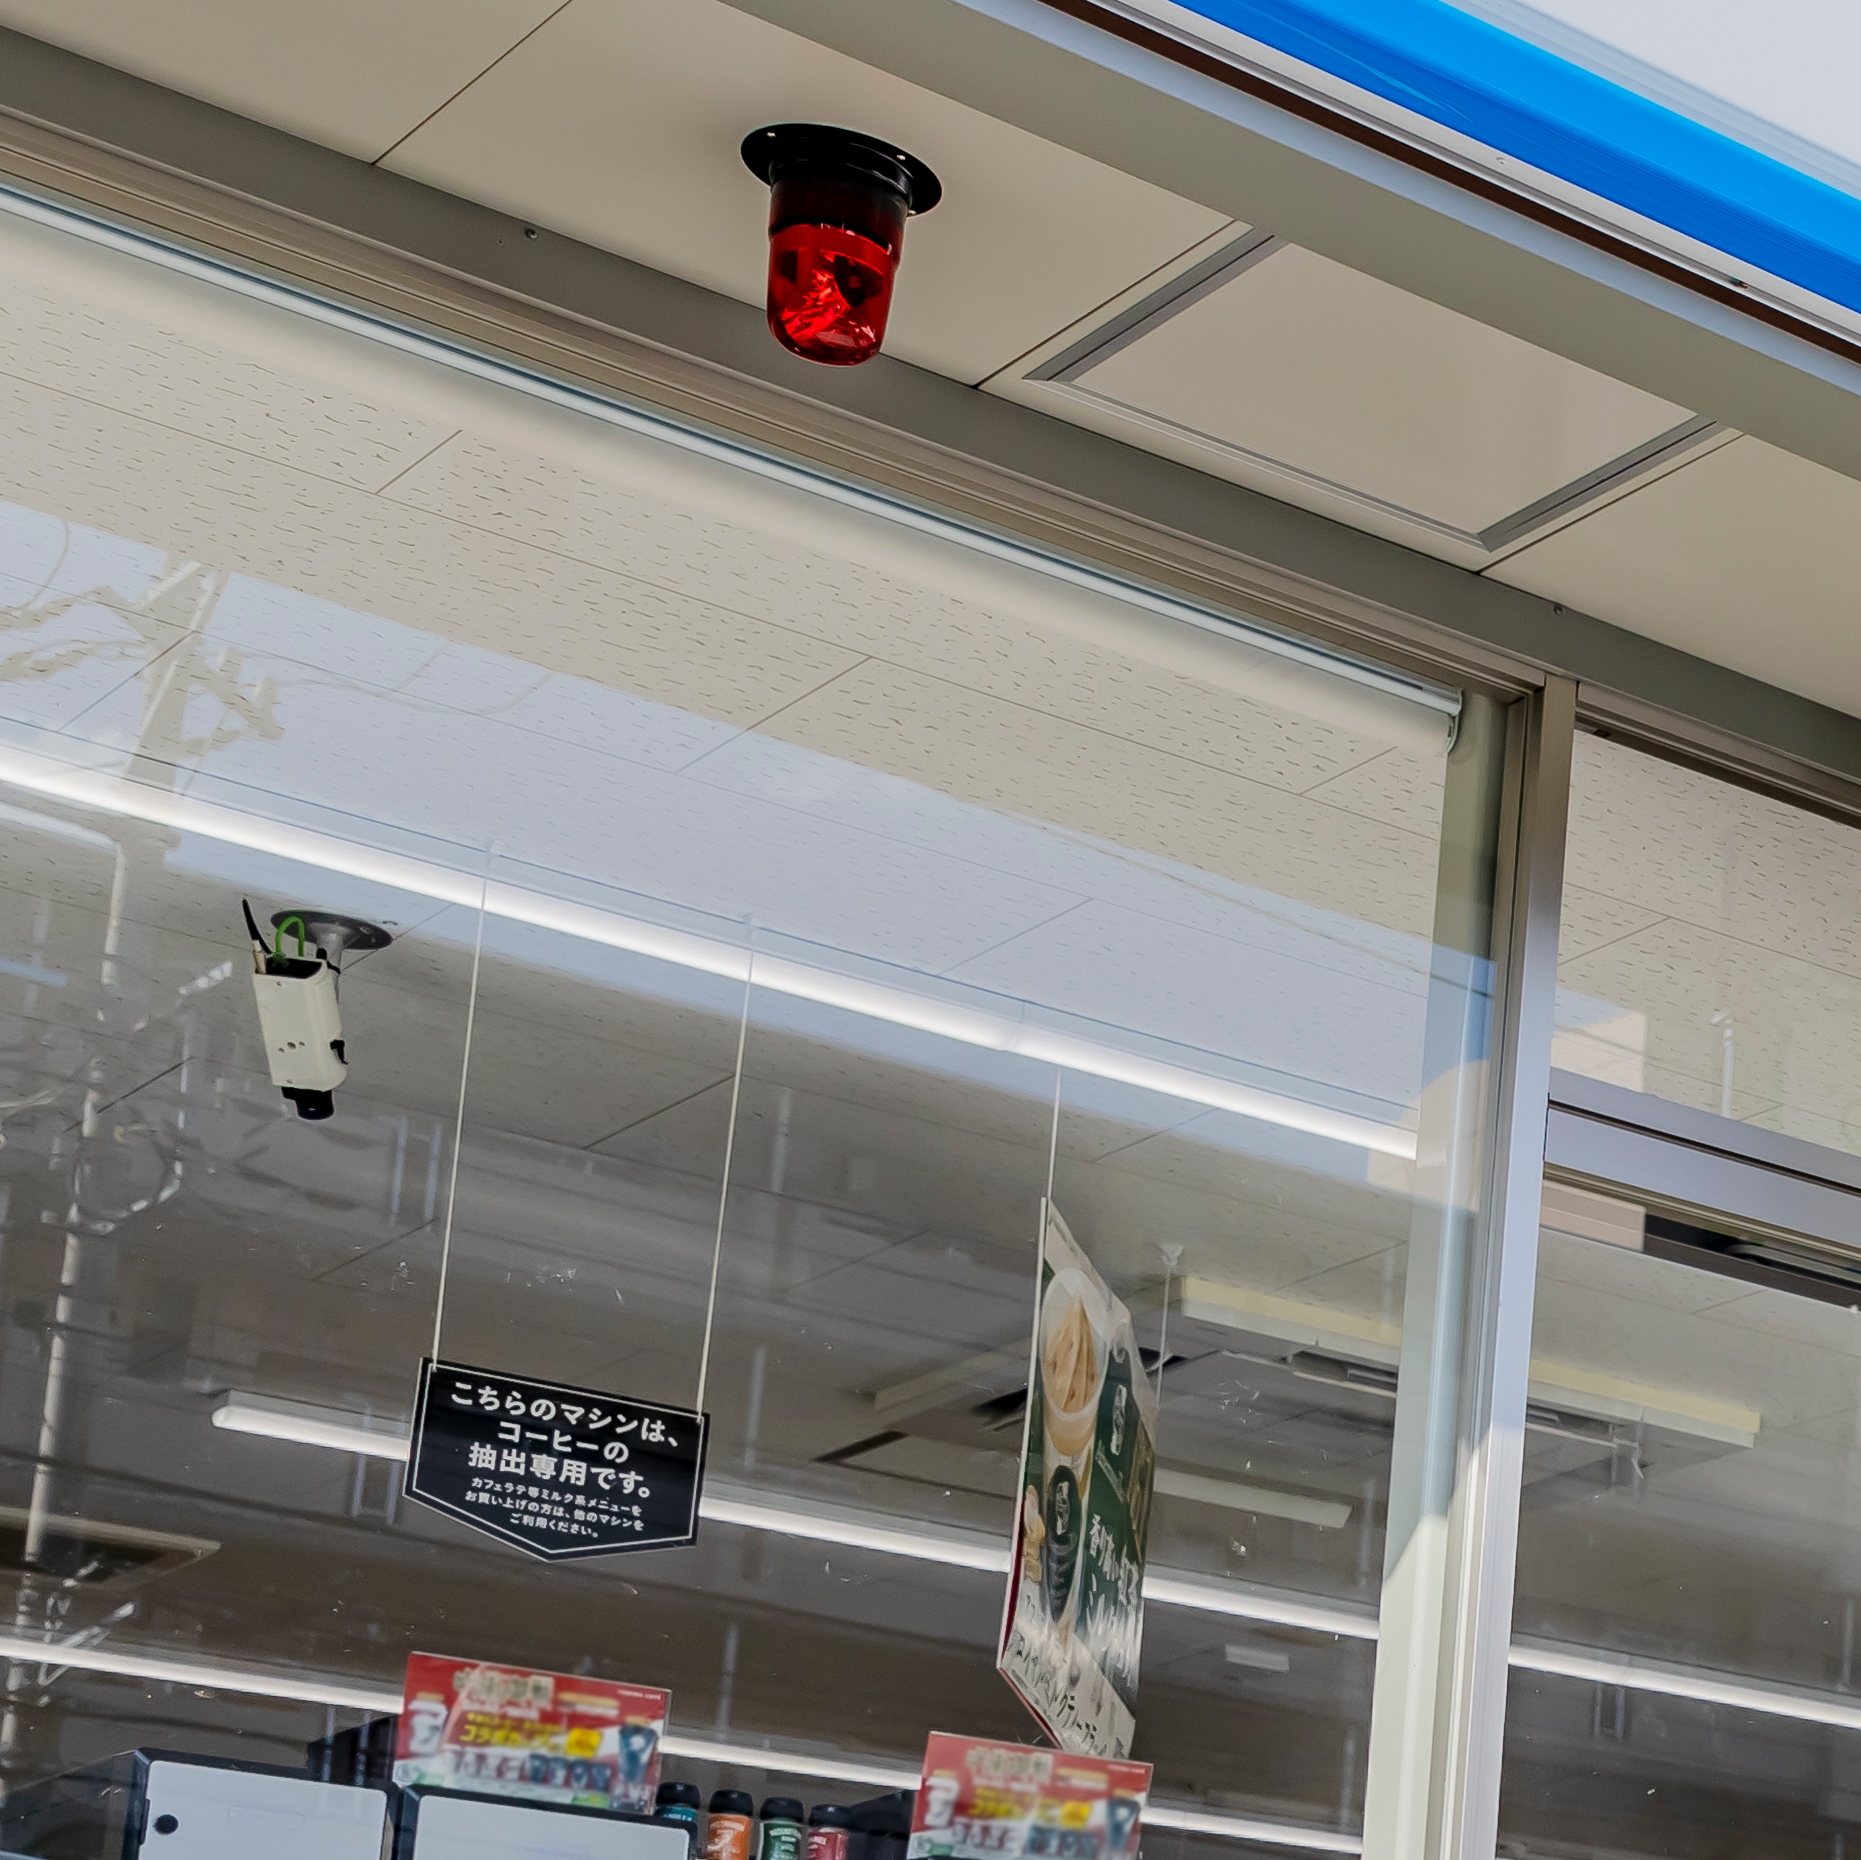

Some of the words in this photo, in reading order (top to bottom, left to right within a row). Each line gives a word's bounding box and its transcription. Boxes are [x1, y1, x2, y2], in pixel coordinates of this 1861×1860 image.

[451, 1381, 678, 1447] こちらのマシンは、
[498, 1421, 629, 1463] コーヒーの
[468, 1442, 650, 1498] 抽出専用です。
[465, 1490, 644, 1531] お買い上げの方は、他のマシンを
[471, 1477, 642, 1517] カフェラテ等ミルク系メニューを
[510, 1513, 598, 1538] ご利用ください。
